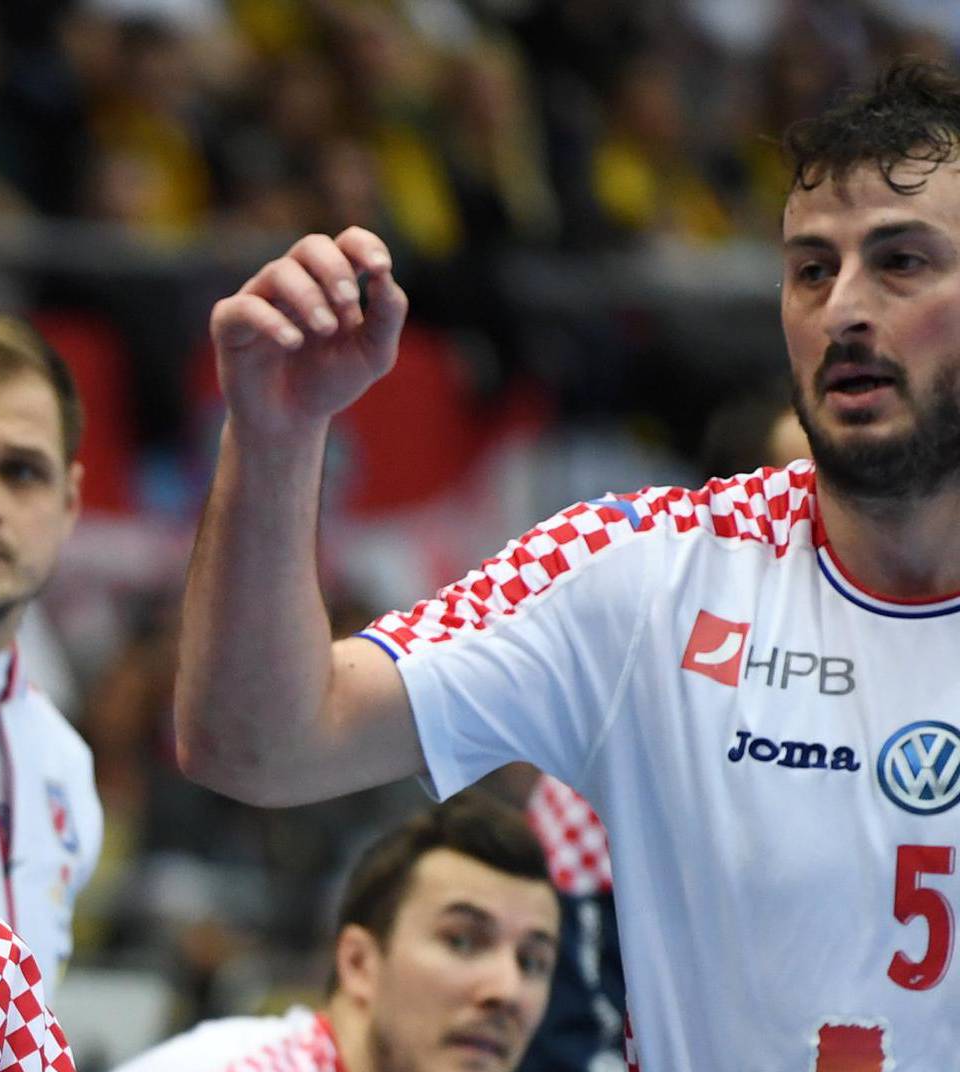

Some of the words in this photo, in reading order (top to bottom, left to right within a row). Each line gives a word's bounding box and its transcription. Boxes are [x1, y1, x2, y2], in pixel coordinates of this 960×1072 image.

[743, 644, 857, 697] HPB
[728, 731, 861, 772] Joma
[887, 844, 956, 991] 5
